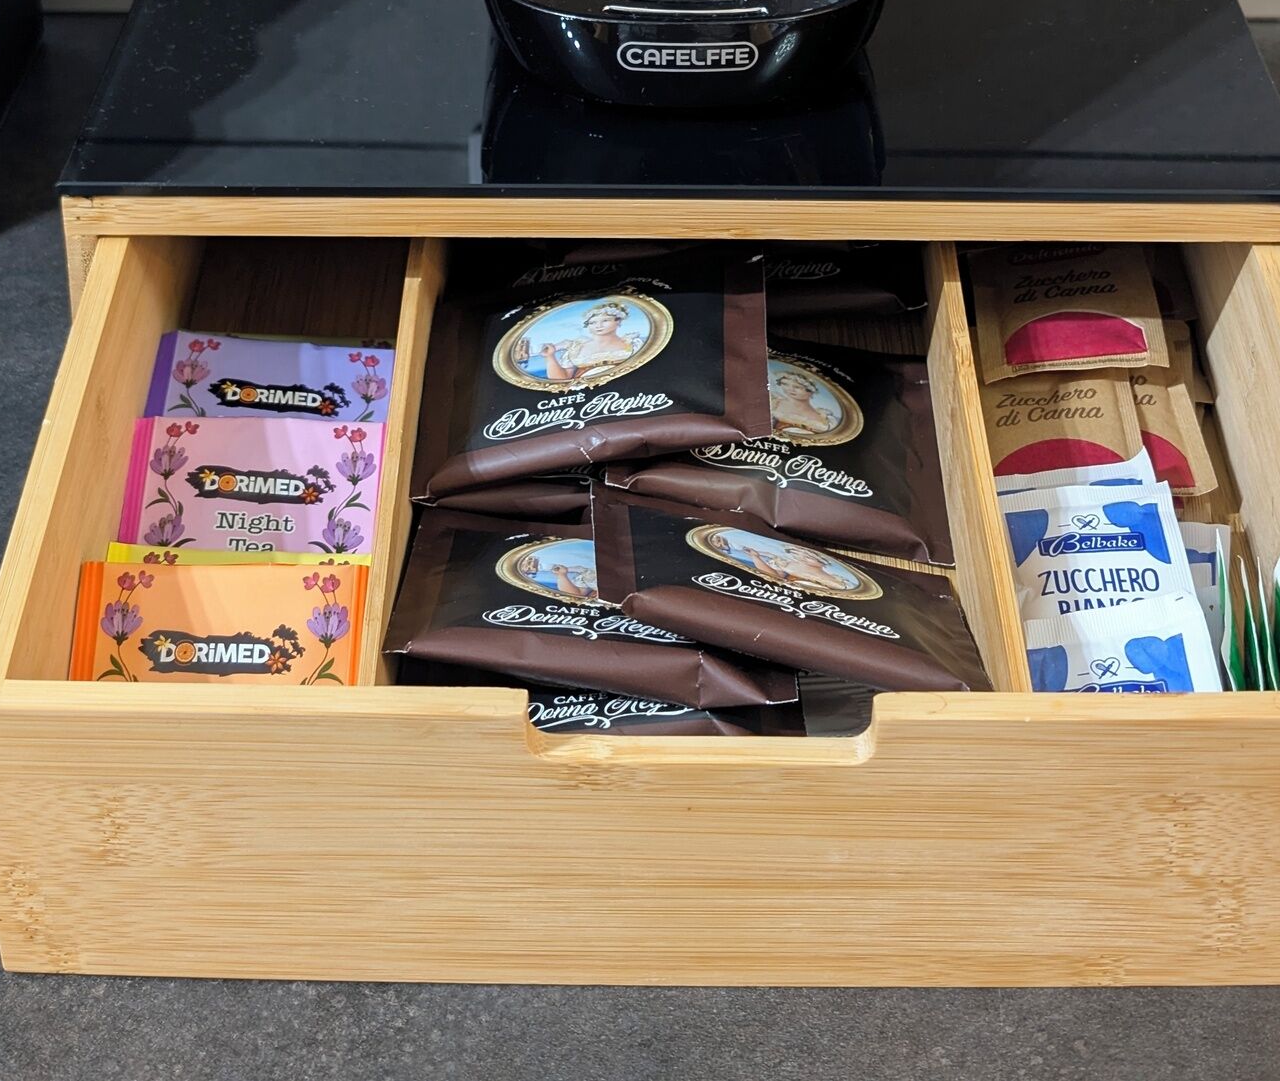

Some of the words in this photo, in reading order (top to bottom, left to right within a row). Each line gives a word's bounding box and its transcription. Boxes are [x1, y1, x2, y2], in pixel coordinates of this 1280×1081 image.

[625, 48, 751, 66] CAFELFFE
[1014, 270, 1111, 290] Zucchero
[1014, 290, 1038, 305] di
[1044, 282, 1119, 300] Canna
[537, 393, 586, 410] CAFFÈ
[995, 386, 1097, 409] Zucchero
[483, 407, 577, 440] Donna
[580, 391, 674, 418] Regina
[995, 406, 1021, 428] di
[1027, 404, 1104, 423] Canna
[784, 455, 873, 497] Regina
[215, 511, 295, 535] Night
[1048, 532, 1138, 556] Belbake
[1036, 567, 1160, 597] ZUCCHERO
[481, 604, 589, 629] Donna
[545, 605, 601, 617] CAFFÈ
[691, 572, 796, 607] Donna
[799, 600, 901, 639] Regina
